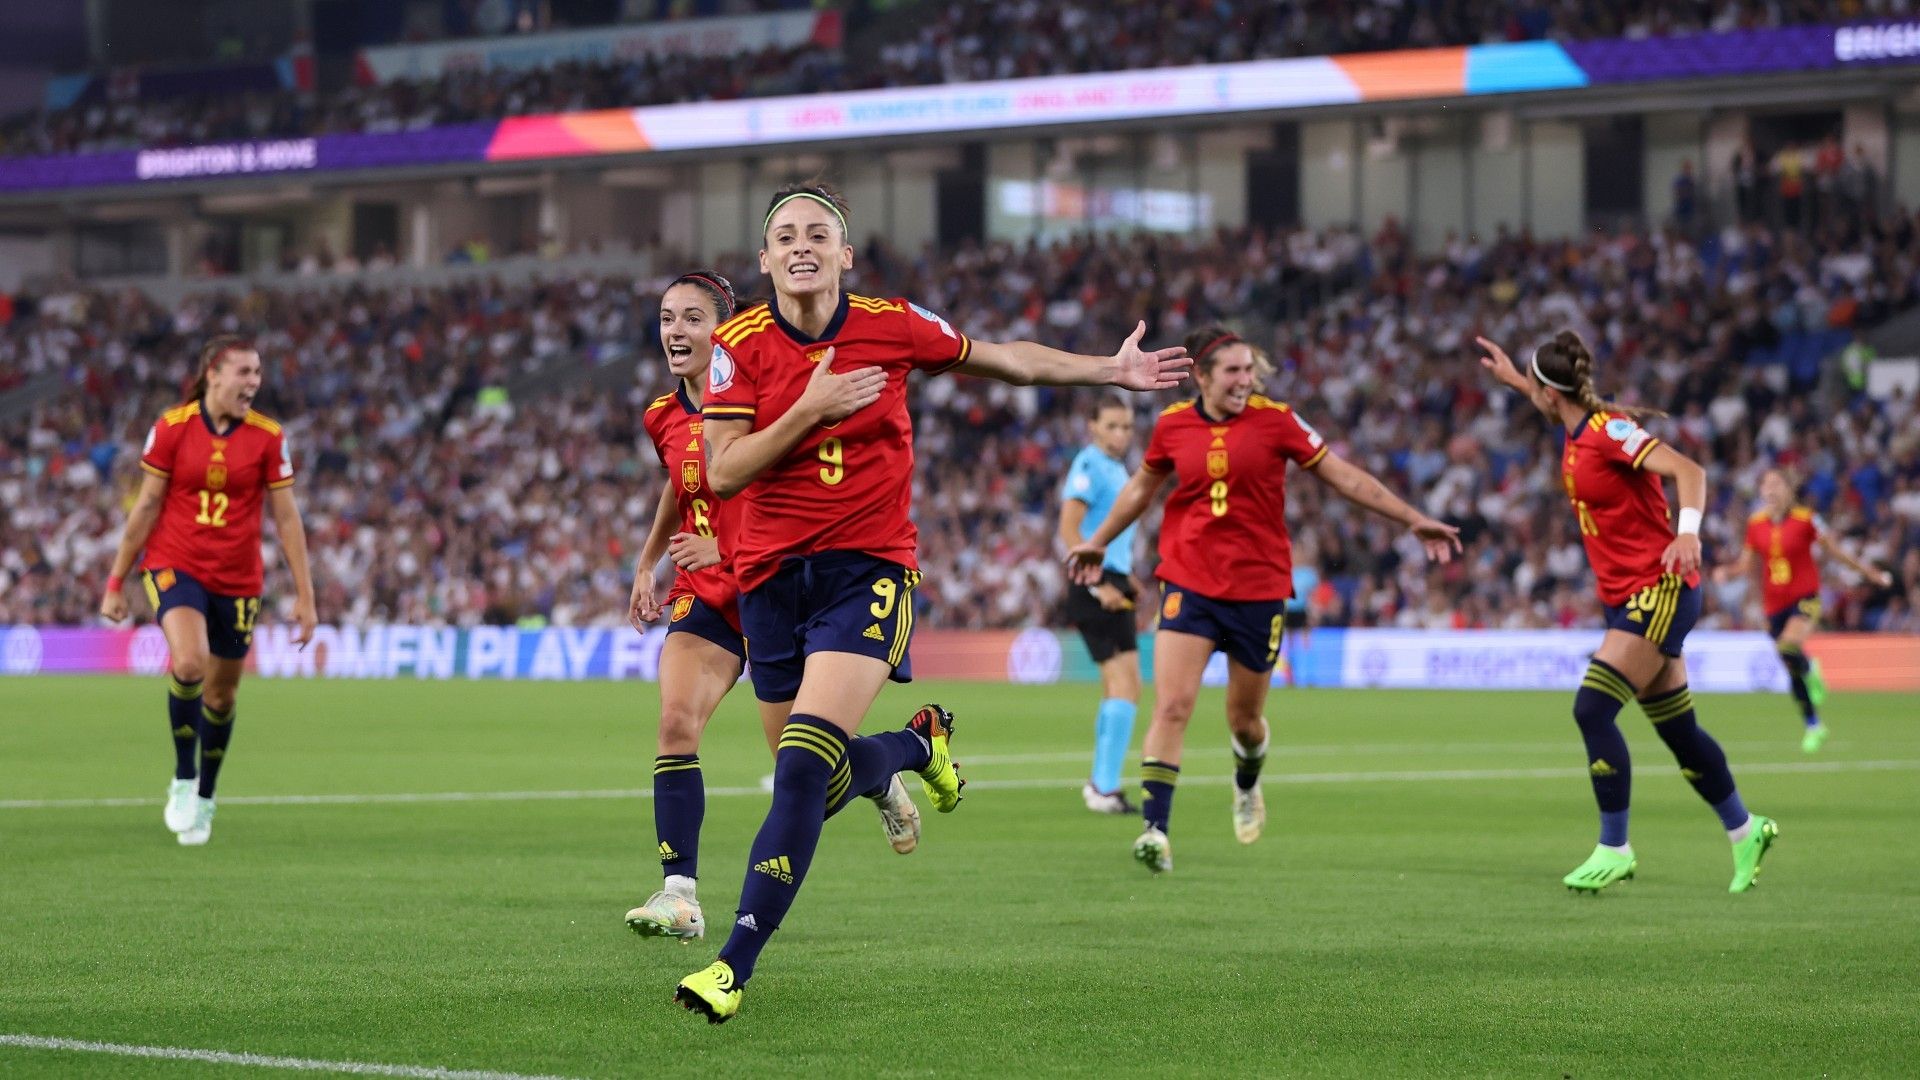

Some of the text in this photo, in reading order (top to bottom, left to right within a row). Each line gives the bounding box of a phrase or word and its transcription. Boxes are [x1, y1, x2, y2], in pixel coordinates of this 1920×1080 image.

[136, 144, 239, 179] BRIGHTON
[260, 139, 317, 170] HOVE
[819, 436, 844, 485] 9
[195, 490, 229, 527] 12
[692, 498, 714, 539] 6
[1209, 480, 1229, 517] 8
[233, 596, 258, 632] 12
[870, 577, 897, 619] 9
[254, 624, 457, 679] WOMEN
[467, 624, 603, 680] PLAY
[754, 863, 794, 885] adidas
